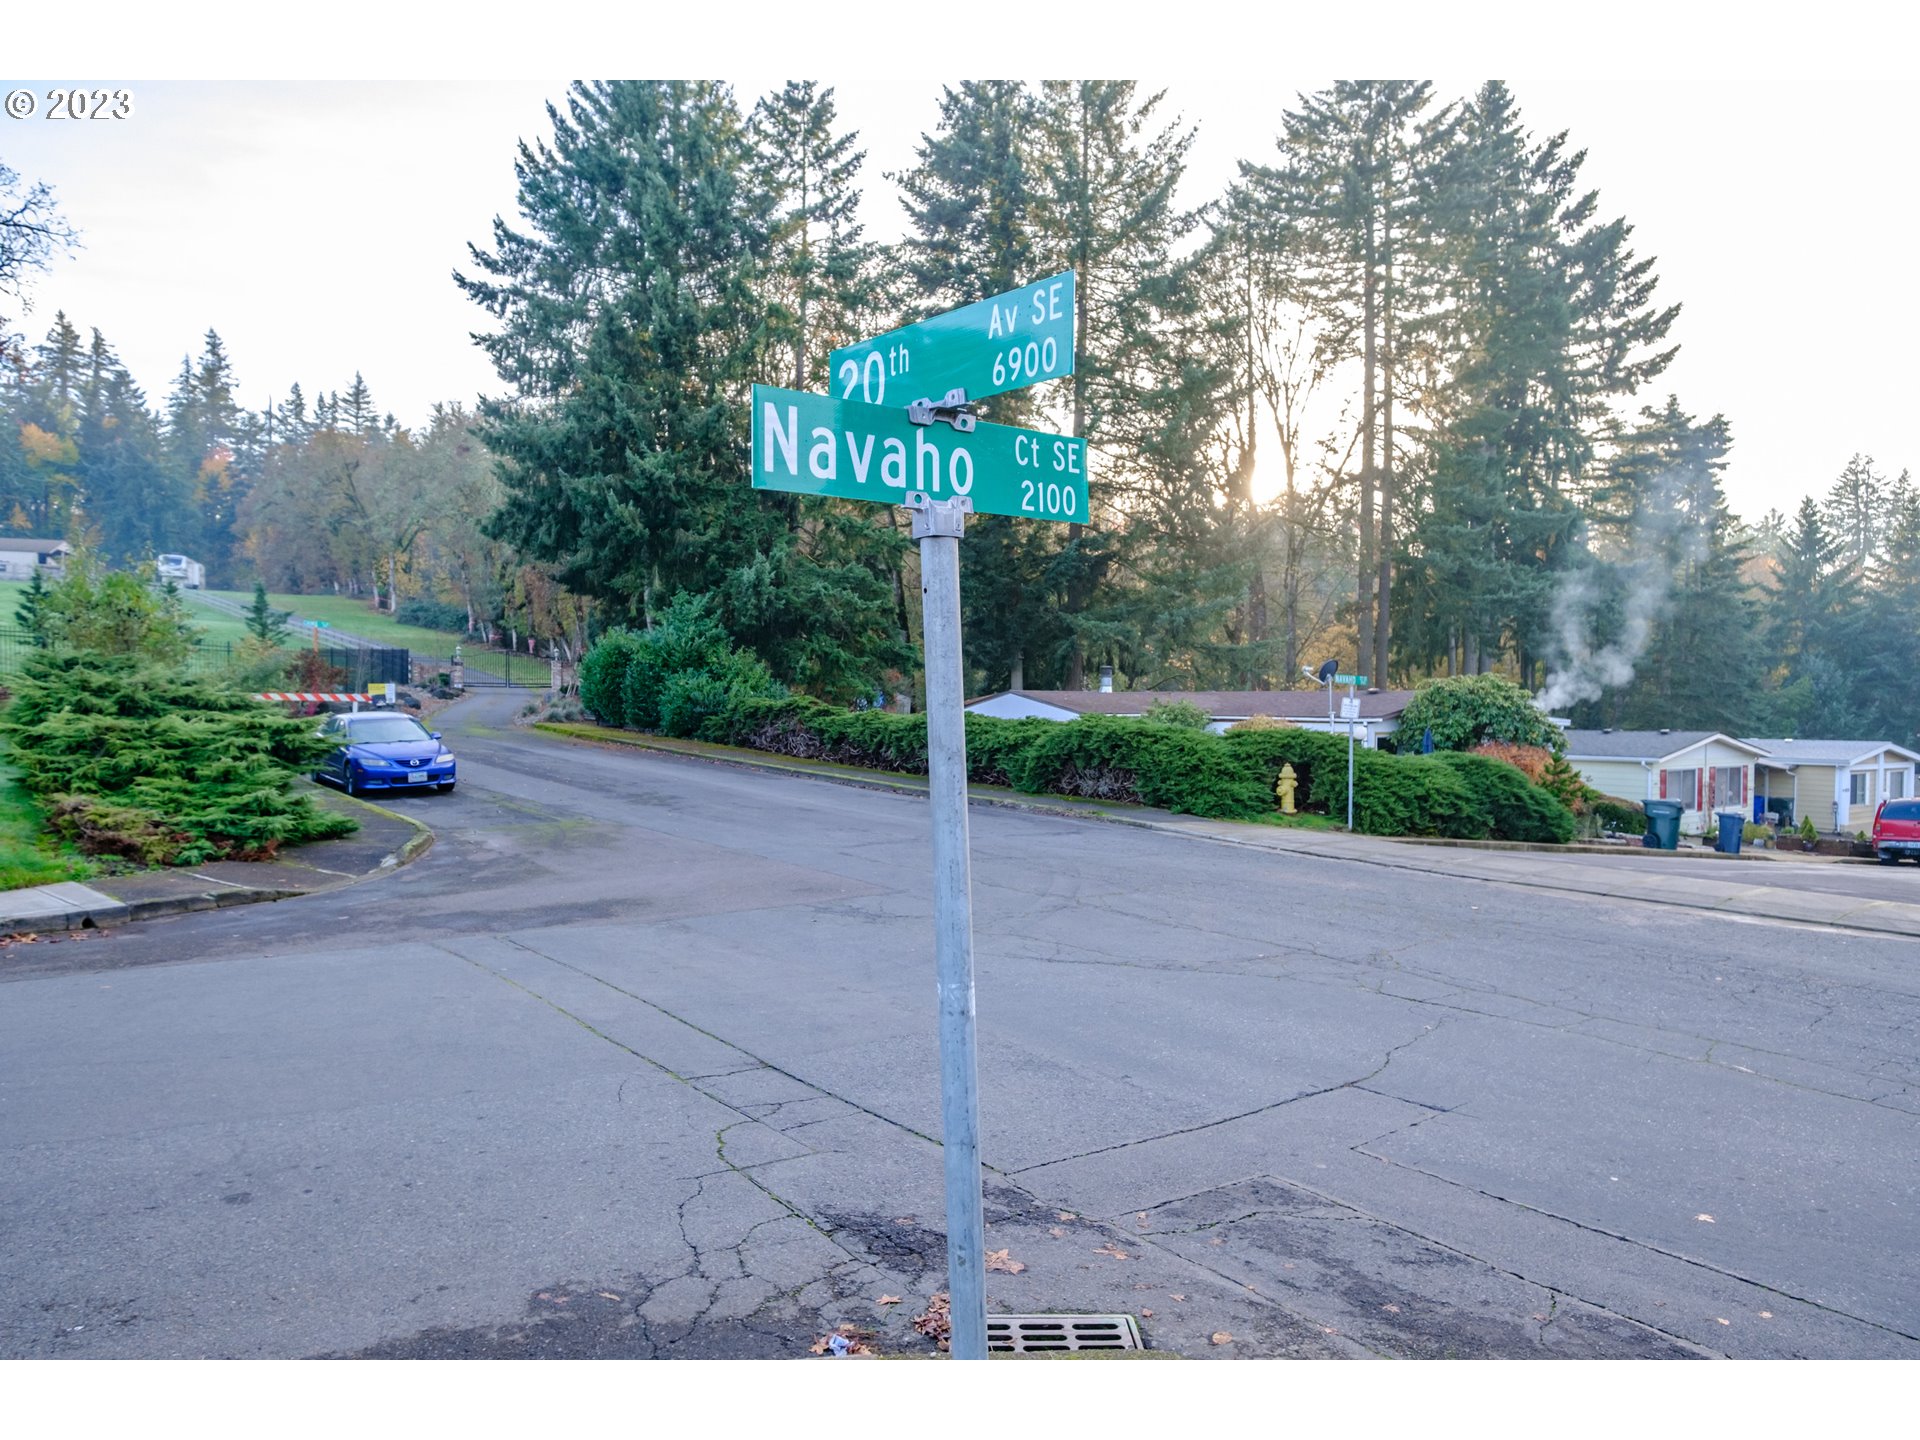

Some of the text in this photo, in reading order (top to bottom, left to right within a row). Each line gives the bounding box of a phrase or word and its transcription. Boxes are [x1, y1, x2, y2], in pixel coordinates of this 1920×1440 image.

[838, 282, 1063, 405] 20th Av SE
[992, 337, 1057, 386] 6900
[763, 401, 1080, 496] Navaho Ct SE
[1021, 480, 1076, 516] 2100
